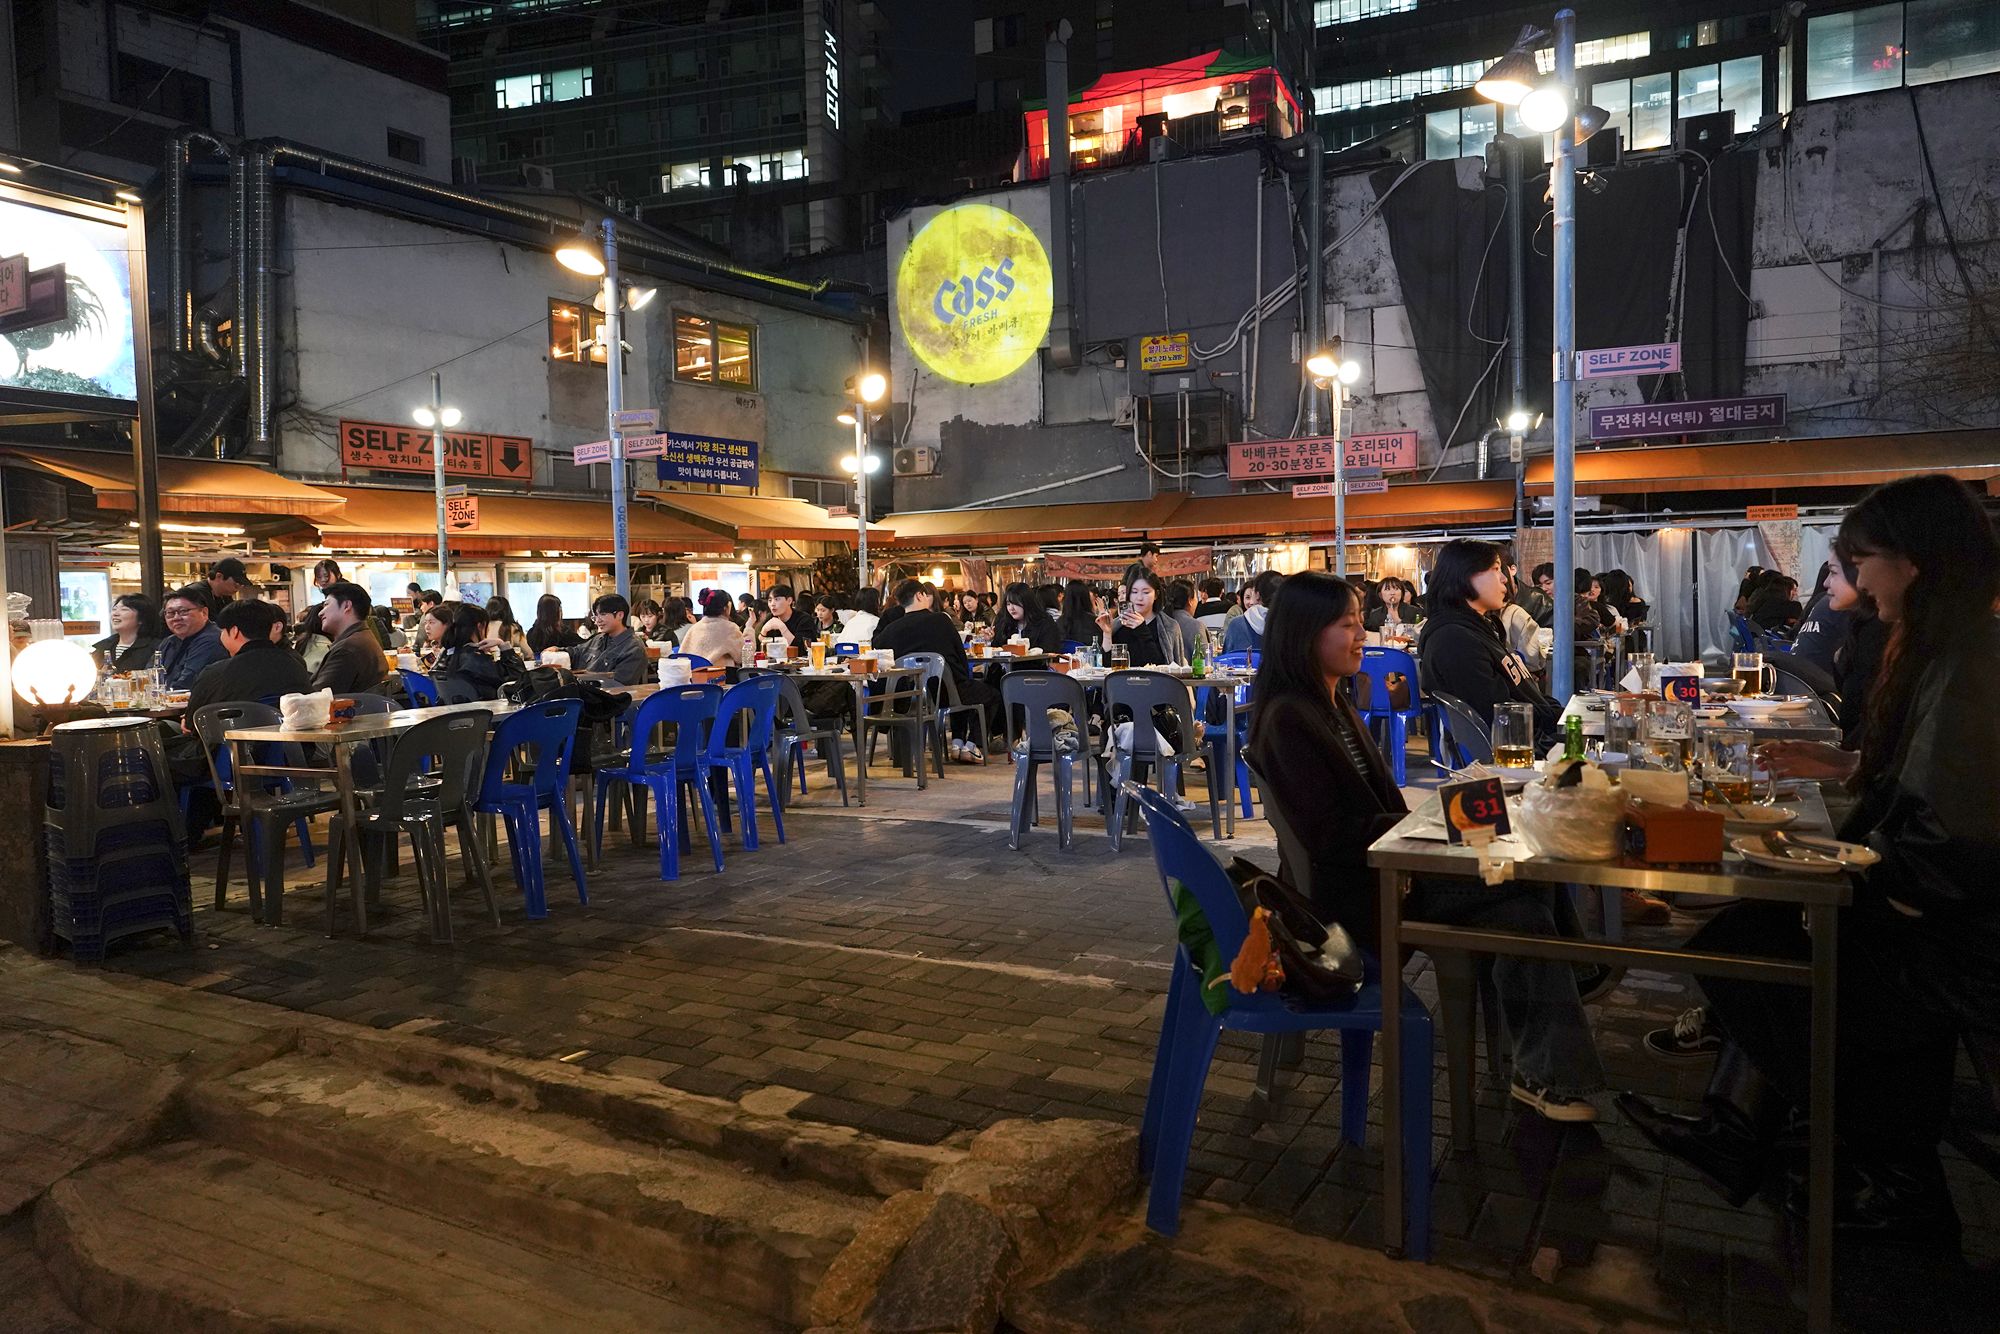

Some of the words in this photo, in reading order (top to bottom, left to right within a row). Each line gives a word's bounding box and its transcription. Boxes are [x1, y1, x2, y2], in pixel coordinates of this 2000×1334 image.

[963, 308, 998, 330] FRESH
[1589, 352, 1626, 366] SELF
[1629, 347, 1672, 361] ZONE
[1600, 411, 1703, 431] 무전취식(먹튀)
[1709, 403, 1776, 424] 절대금지
[348, 428, 410, 452] SELF
[628, 439, 644, 449] SELF
[645, 437, 664, 447] ZONE
[577, 447, 591, 456] SELF
[591, 444, 608, 454] ZONE
[668, 439, 694, 450] 카스에서
[696, 441, 710, 452] 가장
[712, 442, 726, 454] 최근
[728, 444, 748, 456] 생산된
[1242, 445, 1290, 461] 바베큐는
[1296, 441, 1346, 456] 주문즉
[1352, 437, 1403, 451] 조리되어
[350, 450, 373, 463] 생수
[388, 453, 423, 466] 앞치마
[447, 458, 468, 470] 티슈
[473, 461, 482, 471] 등
[716, 457, 729, 467] 우선
[1249, 457, 1327, 473] 20-30분정도
[1333, 452, 1397, 467] 요됩니다
[678, 467, 691, 477] 맛이
[693, 468, 713, 478] 확실히
[1296, 485, 1311, 493] SELF
[1367, 480, 1385, 488] ZONE
[448, 501, 470, 511] SELF
[449, 510, 476, 521] -ZONE
[1689, 678, 1697, 687] C
[1680, 687, 1697, 698] 30
[1487, 781, 1497, 794] C
[1473, 797, 1501, 819] 31
